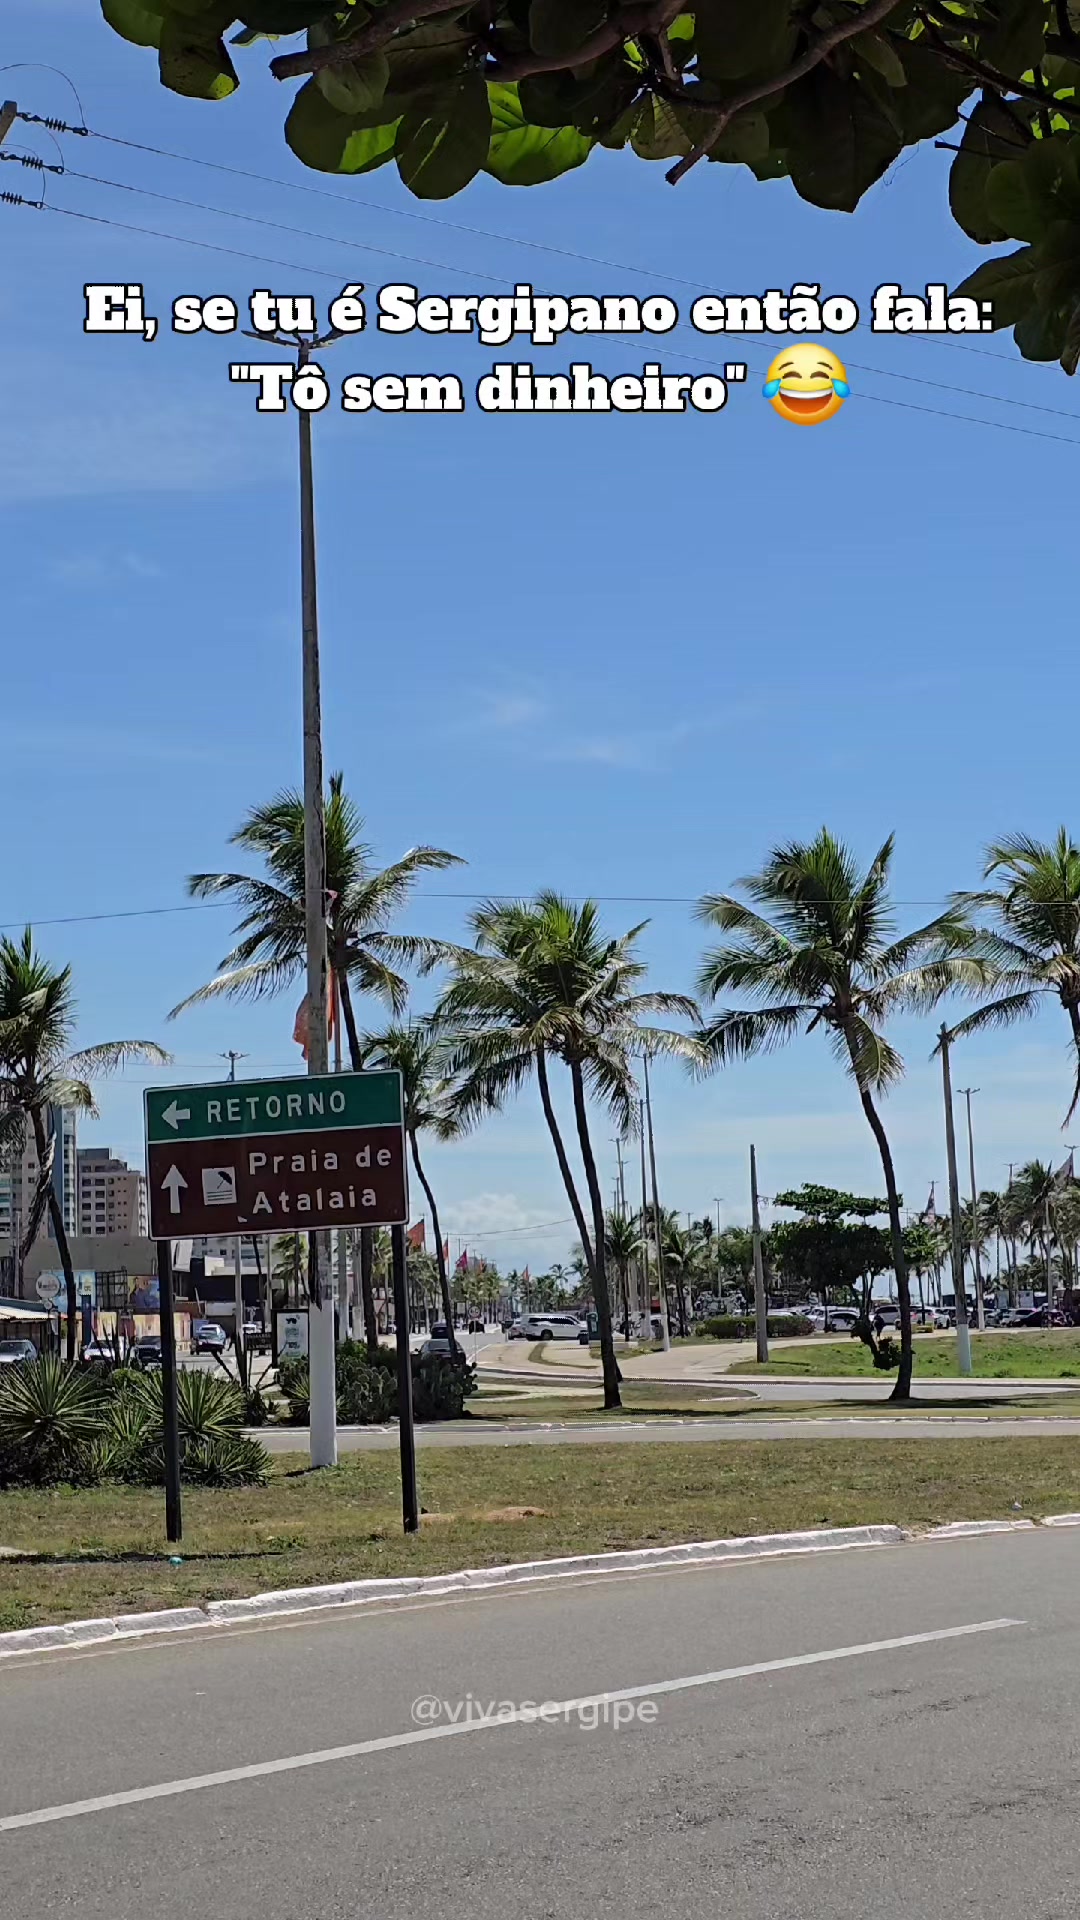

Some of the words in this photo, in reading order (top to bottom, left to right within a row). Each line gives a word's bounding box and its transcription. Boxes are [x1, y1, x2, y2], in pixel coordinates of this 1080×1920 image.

[206, 1090, 346, 1124] RETORNO
[248, 1149, 339, 1176] Praia
[355, 1144, 392, 1169] de
[251, 1185, 377, 1215] Atalaia
